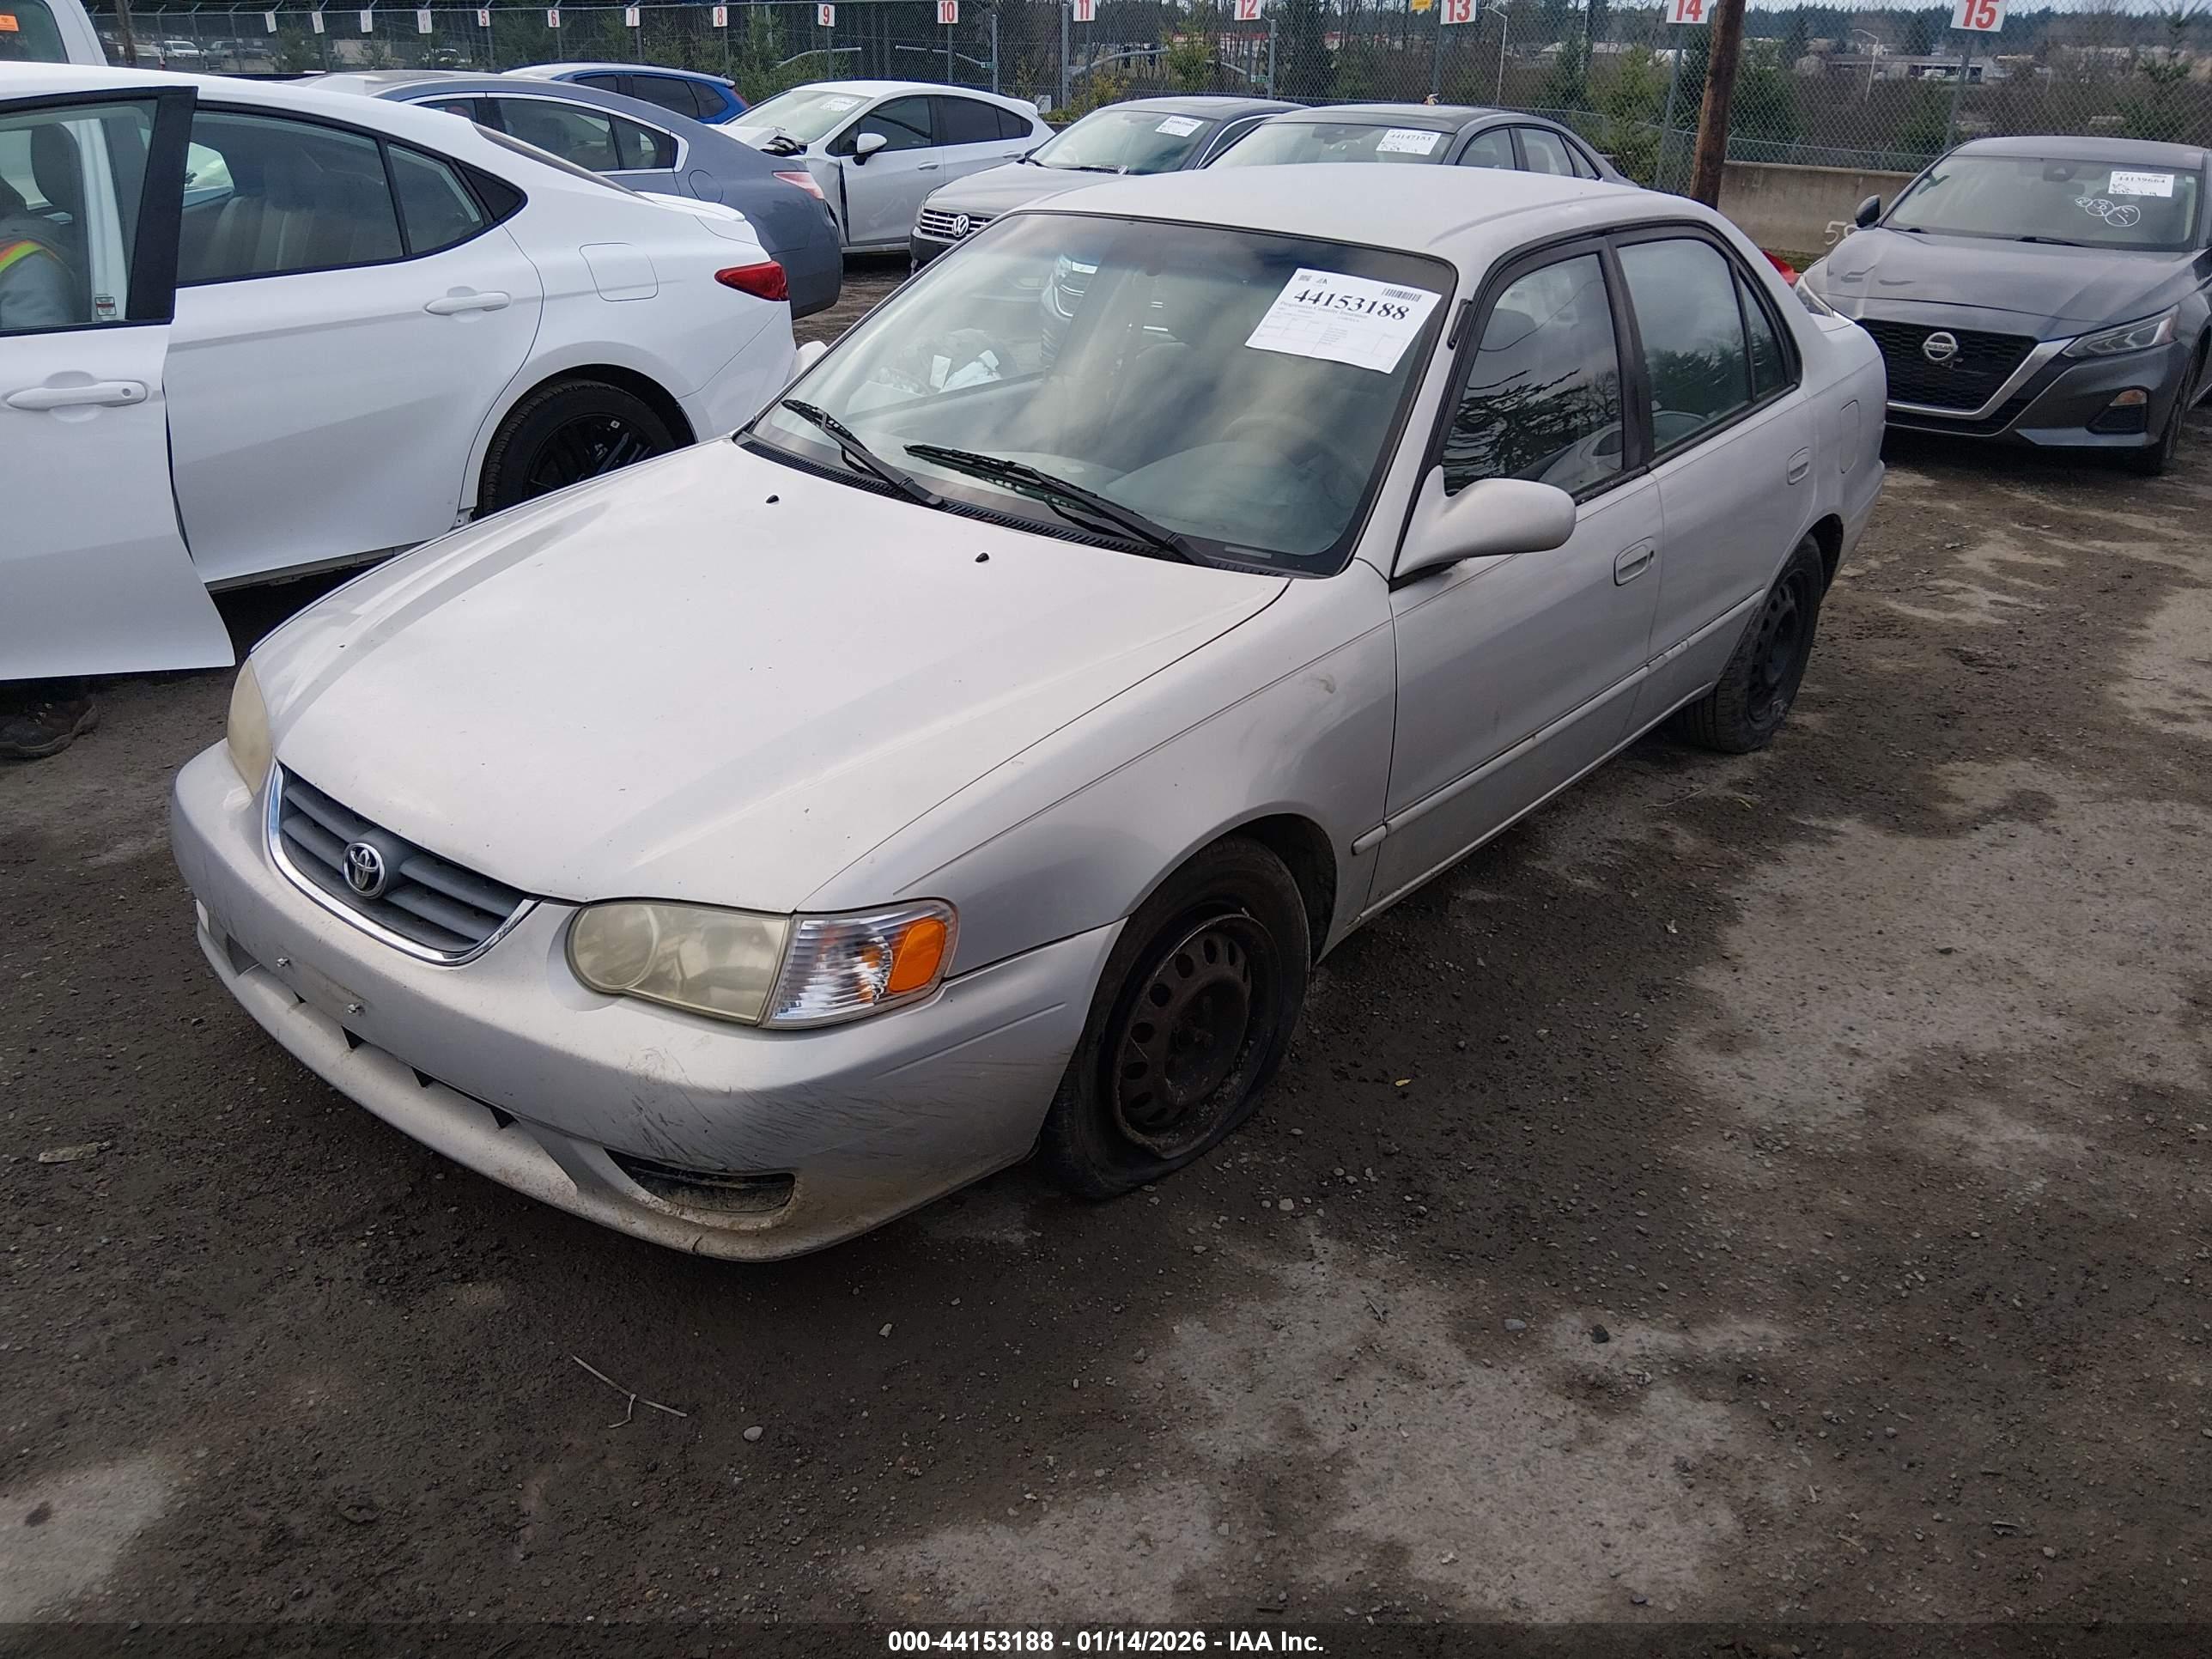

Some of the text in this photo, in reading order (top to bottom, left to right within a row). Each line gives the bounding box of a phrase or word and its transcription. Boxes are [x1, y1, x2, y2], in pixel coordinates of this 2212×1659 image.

[481, 10, 487, 26] 5
[551, 10, 556, 27] 6
[630, 9, 635, 25] 7
[718, 8, 723, 25] 8
[823, 5, 830, 25] 9
[941, 2, 955, 22] 10
[1079, 0, 1090, 20] 11
[1240, 0, 1256, 19] 12
[1448, 0, 1470, 21] 13
[1676, 0, 1702, 21] 14
[1963, 0, 1999, 28] 15
[1294, 289, 1410, 321] 44153188
[1925, 343, 1954, 352] NISSAN
